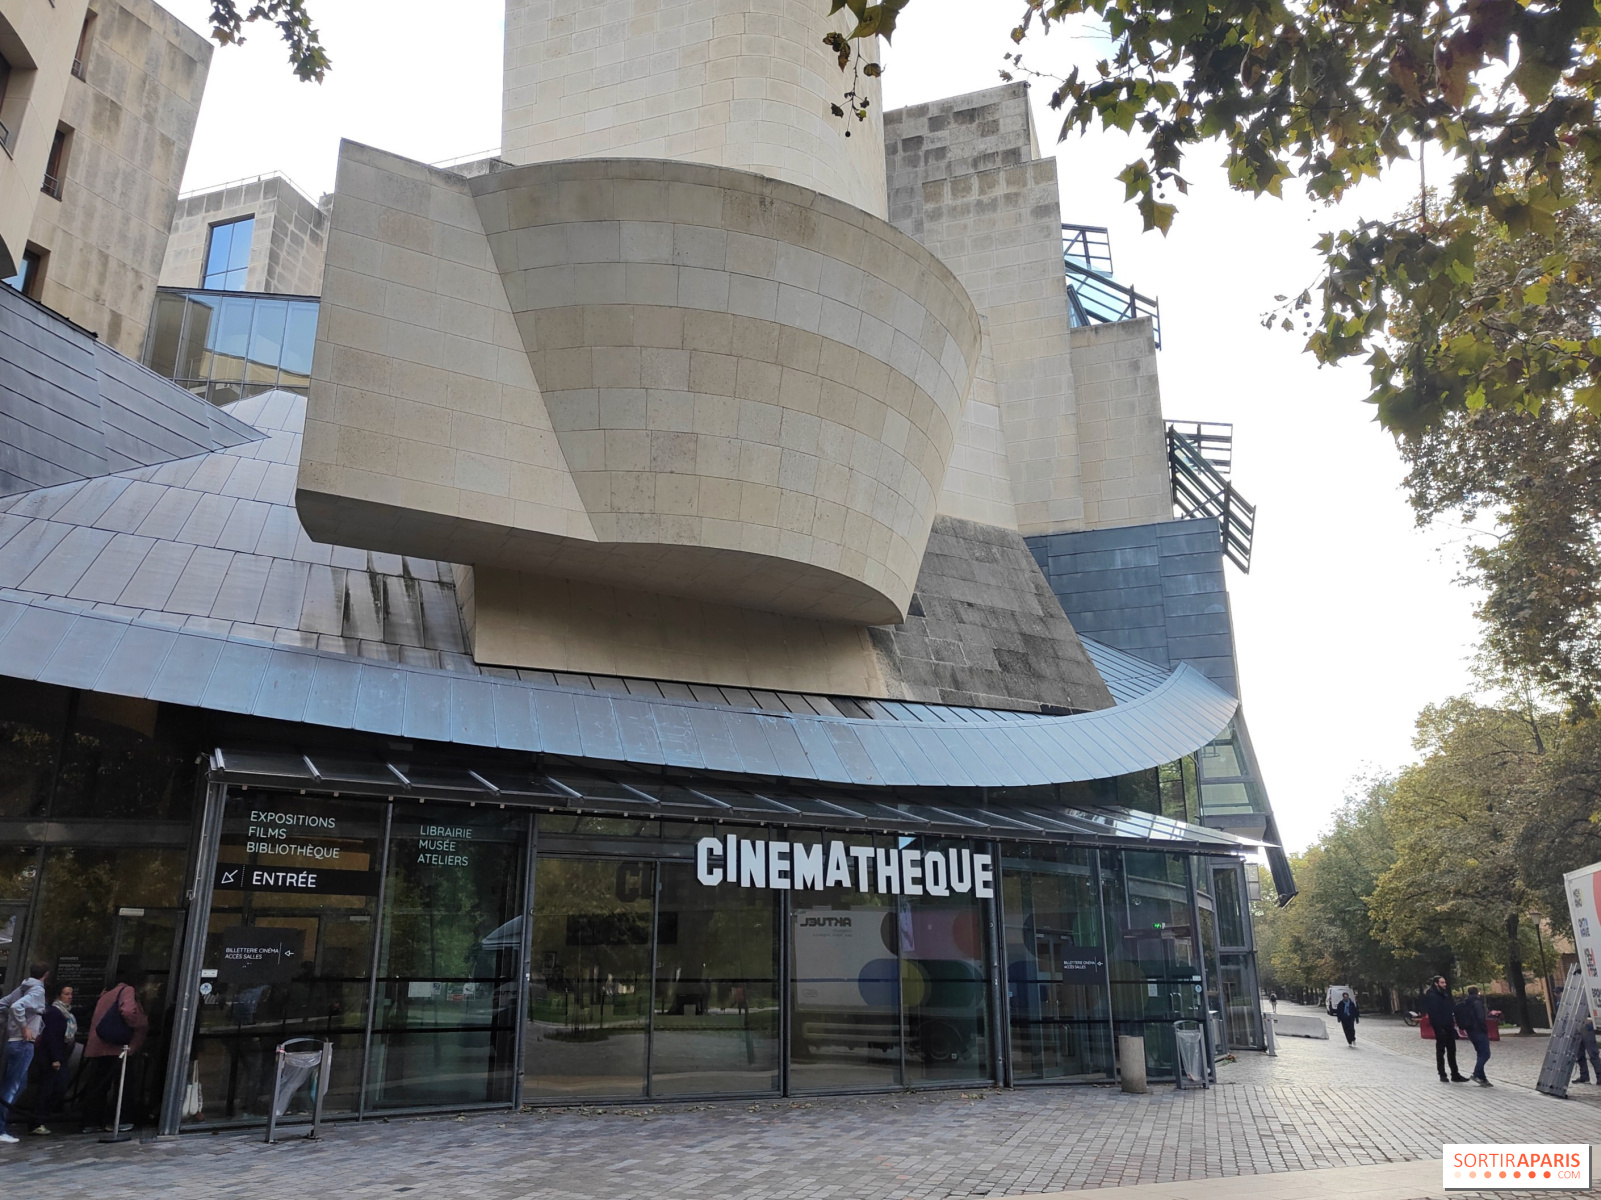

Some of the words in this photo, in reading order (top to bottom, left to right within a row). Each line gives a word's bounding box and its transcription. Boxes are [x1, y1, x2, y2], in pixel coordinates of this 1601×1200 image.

[250, 811, 336, 828] EXPOSITIONS
[248, 826, 287, 839] FILMS
[420, 825, 472, 839] LIBRAIRIE
[246, 841, 340, 860] BIBLIOTHÈQUE
[418, 839, 456, 851] MUSÉE
[417, 853, 469, 866] ATELIERS
[252, 870, 317, 888] ENTRÉE
